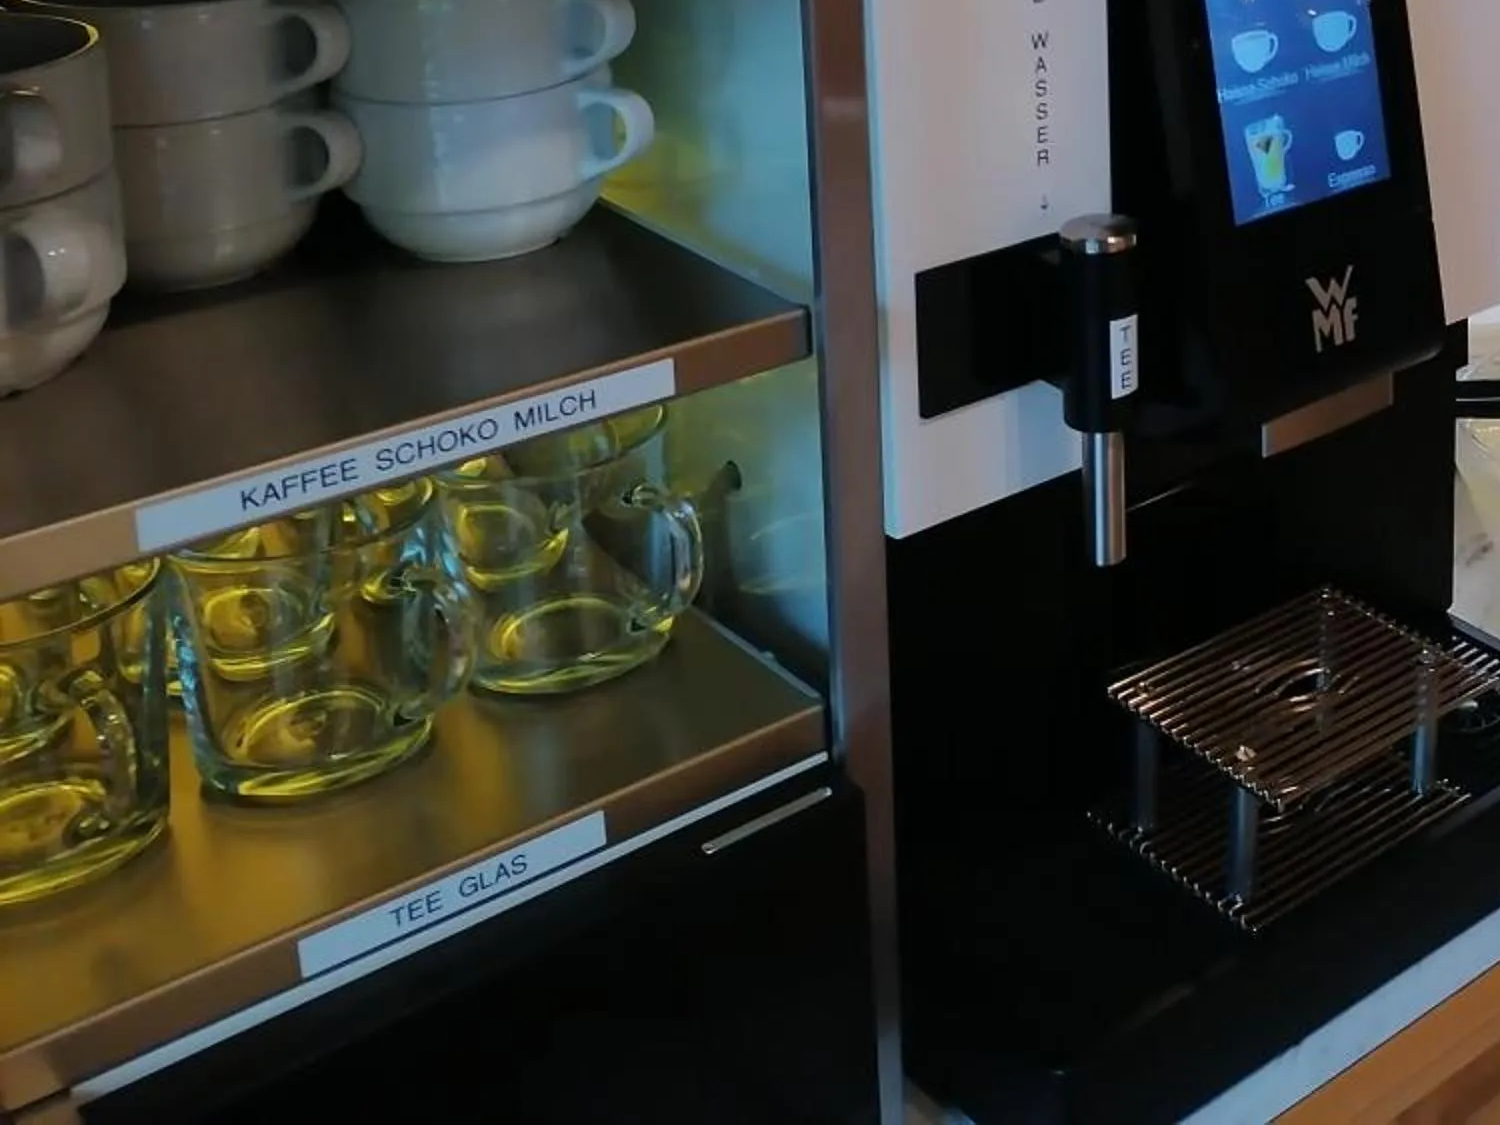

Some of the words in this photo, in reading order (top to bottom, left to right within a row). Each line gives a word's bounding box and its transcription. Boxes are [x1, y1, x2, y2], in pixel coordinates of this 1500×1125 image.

[1031, 31, 1050, 167] WASSER
[1305, 264, 1359, 353] WMF
[1119, 324, 1133, 391] TEE
[240, 456, 360, 512] KAFFEE
[375, 418, 499, 472] SCHOKO
[513, 388, 597, 432] MILCH
[388, 890, 443, 927] TEE
[458, 853, 528, 898] GLAS
